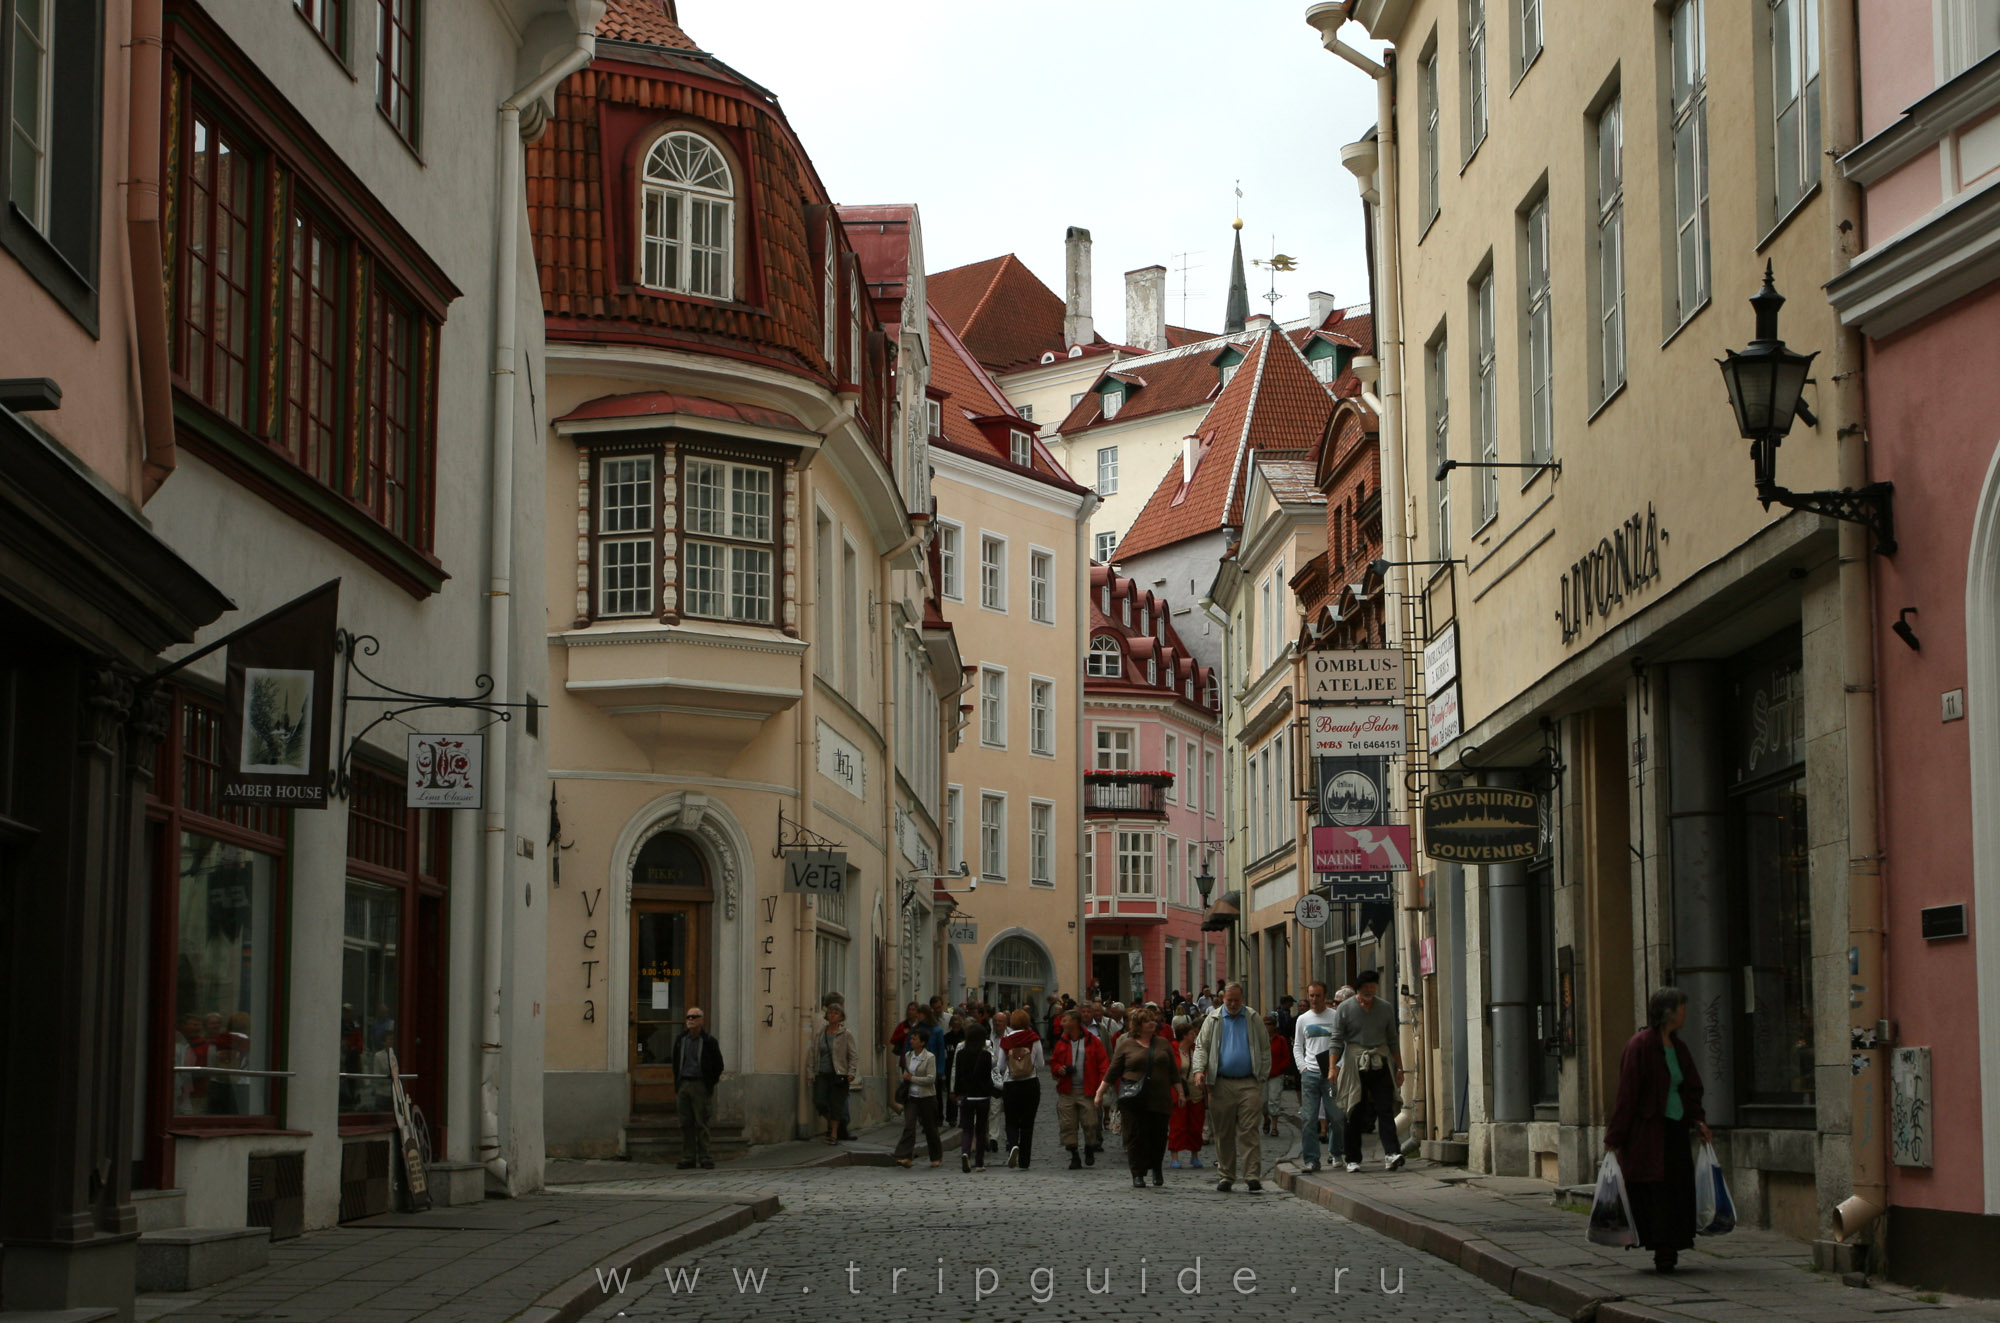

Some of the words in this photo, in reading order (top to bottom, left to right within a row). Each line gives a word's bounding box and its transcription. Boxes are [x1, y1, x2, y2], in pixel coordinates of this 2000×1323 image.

[1559, 500, 1660, 646] LIVONIA
[1315, 656, 1398, 673] ÕMBLUS-
[1316, 678, 1397, 692] ATELJEE
[1315, 716, 1361, 738] Beauty
[1362, 715, 1399, 732] Salon
[1316, 741, 1342, 750] MBS
[1347, 741, 1361, 750] Tel
[1363, 740, 1400, 750] 6464151
[224, 783, 272, 798] AMBER
[276, 785, 323, 799] HOUSE
[1430, 792, 1534, 811] SUVENIIRID
[1431, 842, 1535, 859] SOUVENIRS
[1316, 854, 1362, 866] NALNE
[791, 863, 841, 892] VeTa
[948, 928, 974, 939] VeTa
